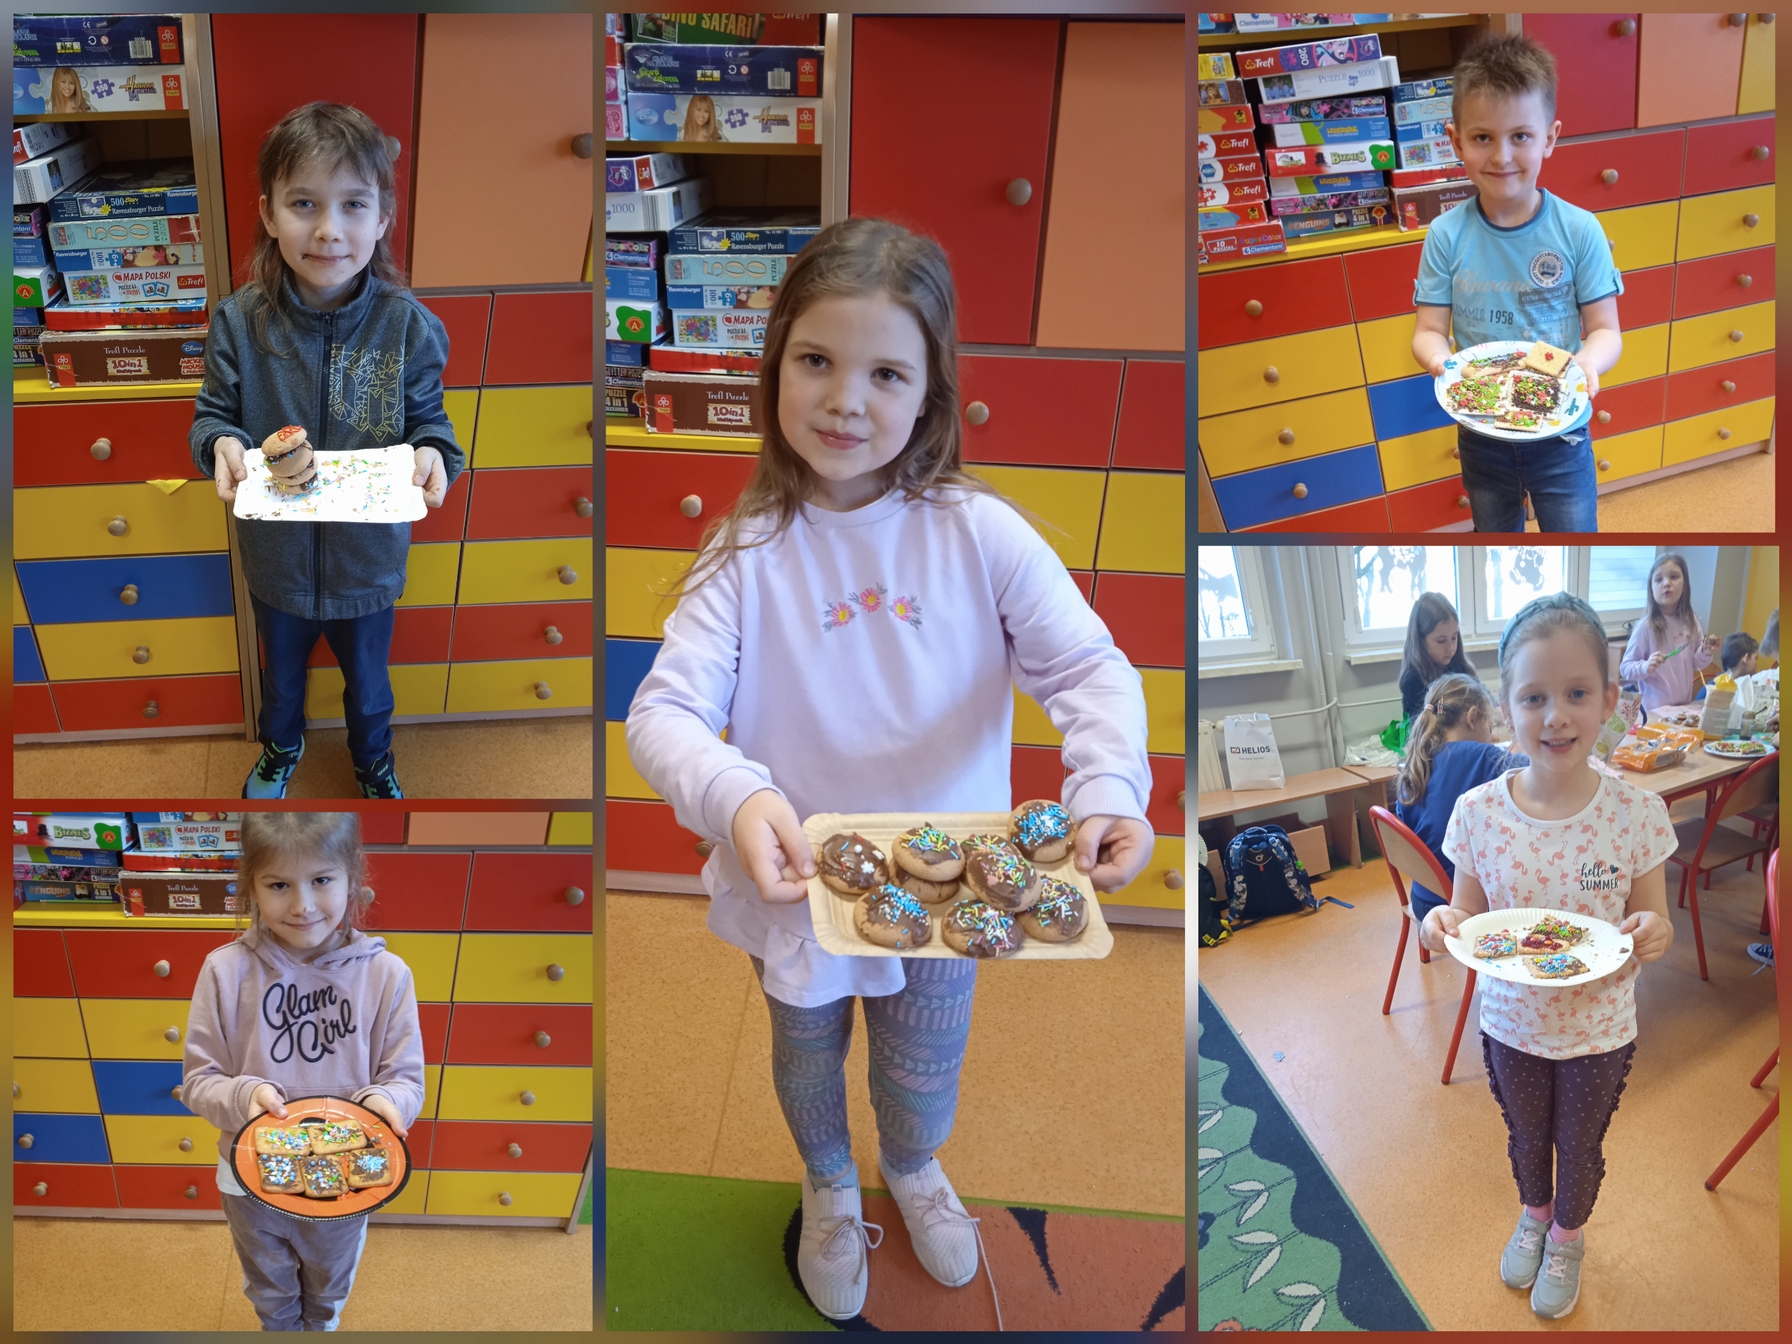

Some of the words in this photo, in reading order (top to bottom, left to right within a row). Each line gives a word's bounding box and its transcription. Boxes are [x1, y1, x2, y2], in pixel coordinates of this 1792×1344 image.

[701, 13, 753, 39] SAFARI
[1239, 19, 1275, 27] Clementoni
[1298, 47, 1310, 66] 260
[1255, 57, 1274, 69] Trefl
[1318, 73, 1348, 83] PUZZLE
[1358, 69, 1375, 78] 1000
[96, 83, 108, 93] 350
[1421, 101, 1453, 115] 50
[730, 113, 742, 122] 350
[1230, 138, 1249, 148] Trefl
[1330, 150, 1367, 164] BIZNES
[1237, 162, 1256, 172] Trefl
[1243, 186, 1261, 195] Trefl
[110, 197, 125, 207] 500
[112, 206, 146, 215] Ravensburger
[611, 203, 635, 213] 1000
[1288, 218, 1331, 231] PENGUINS
[86, 224, 150, 242] 500
[731, 232, 745, 241] 500
[731, 242, 767, 251] Ravensburger
[767, 242, 785, 250] Puzzle
[1250, 243, 1283, 253] Clementoni
[613, 253, 648, 261] Clementoni
[703, 260, 767, 278] 500
[123, 272, 143, 281] MAPA
[145, 271, 171, 280] POLSKI
[187, 277, 204, 285] Trefl
[733, 315, 754, 325] MAPA
[1453, 306, 1485, 322] SUMMER
[1489, 309, 1514, 326] 1958
[122, 346, 145, 354] Puzzle
[612, 378, 643, 386] Clementon
[706, 391, 723, 399] Trefl
[725, 391, 749, 400] Puzzle
[1241, 745, 1271, 755] HELIOS
[53, 825, 91, 840] BIZNES
[183, 826, 199, 834] MAPA
[201, 825, 221, 833] POLSKI
[1581, 861, 1609, 878] hello
[1580, 877, 1619, 891] SUMMER
[29, 886, 71, 895] PENGUINS
[262, 982, 337, 1064] Glam
[296, 998, 357, 1063] Girl
